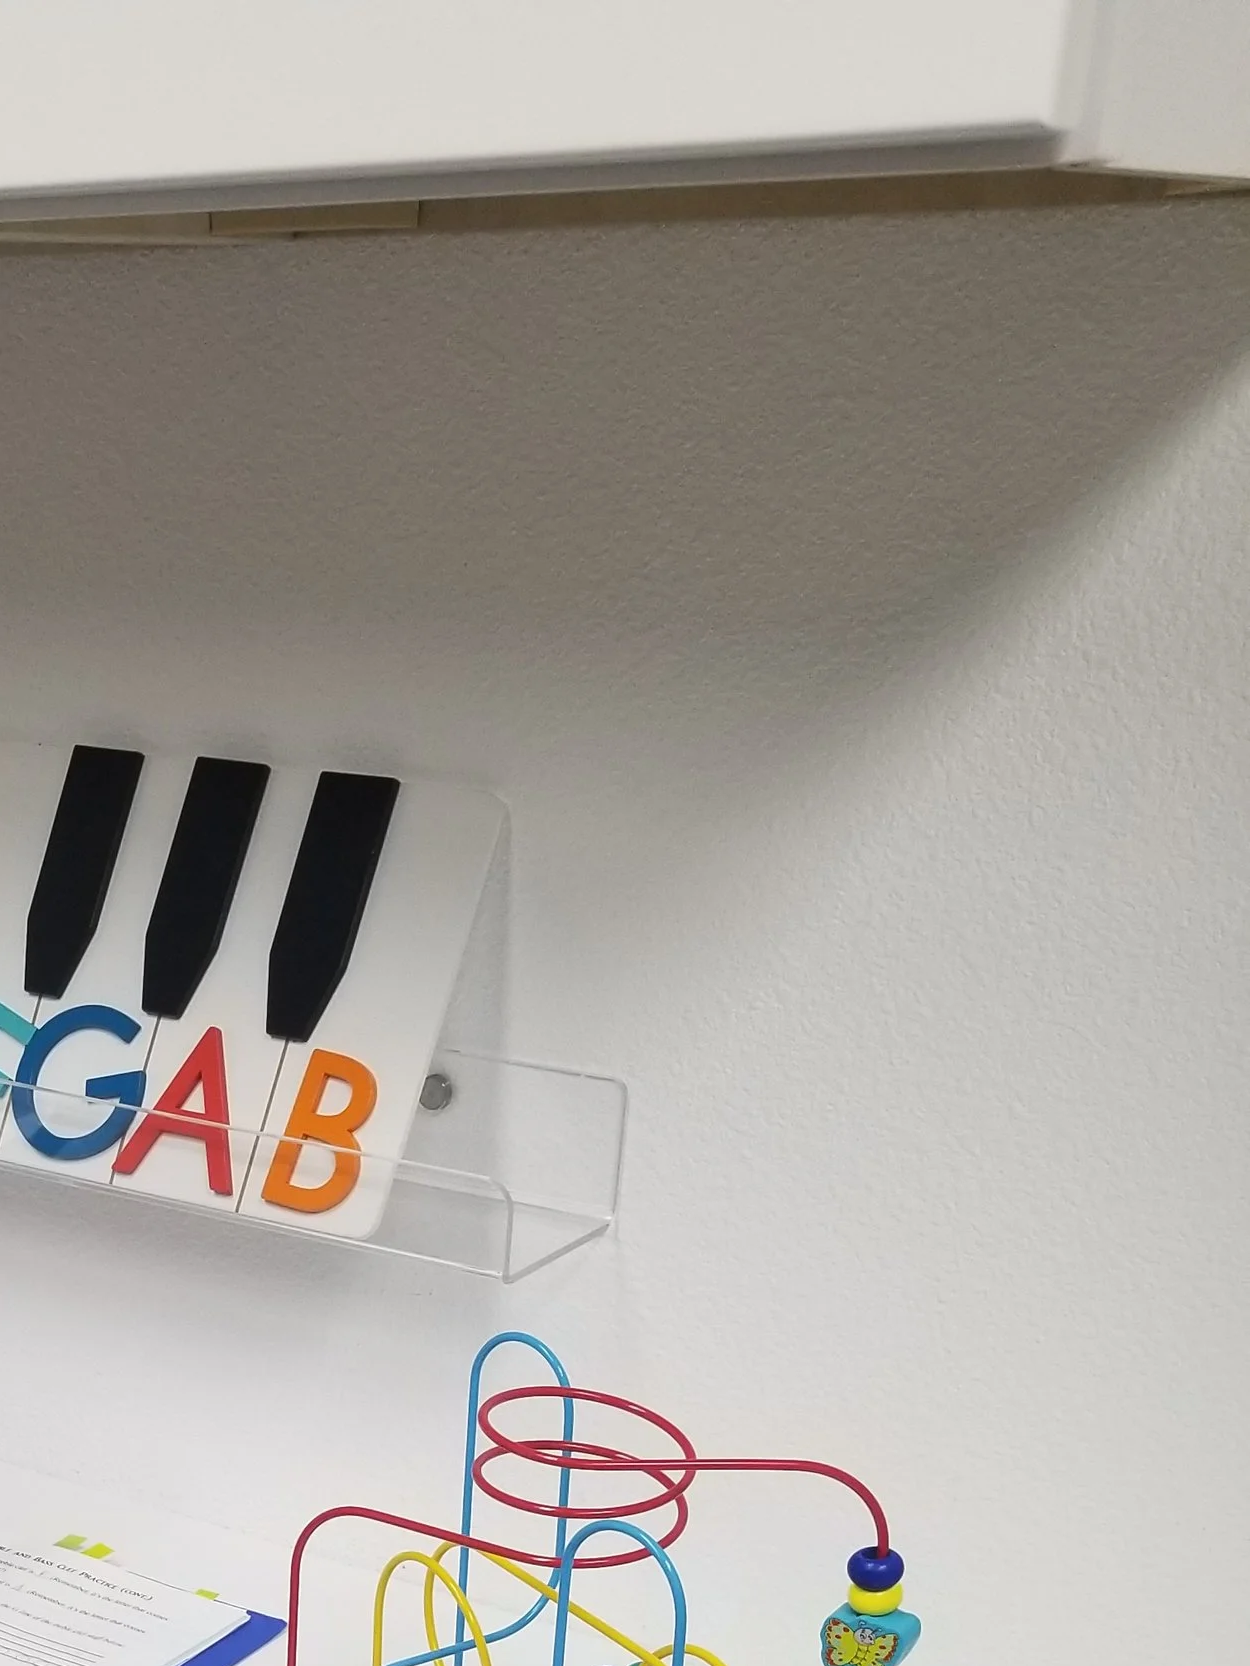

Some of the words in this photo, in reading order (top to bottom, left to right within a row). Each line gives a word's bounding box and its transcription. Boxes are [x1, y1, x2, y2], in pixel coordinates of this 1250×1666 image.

[12, 1004, 147, 1161] G
[112, 1025, 234, 1197] A
[261, 1047, 378, 1214] B
